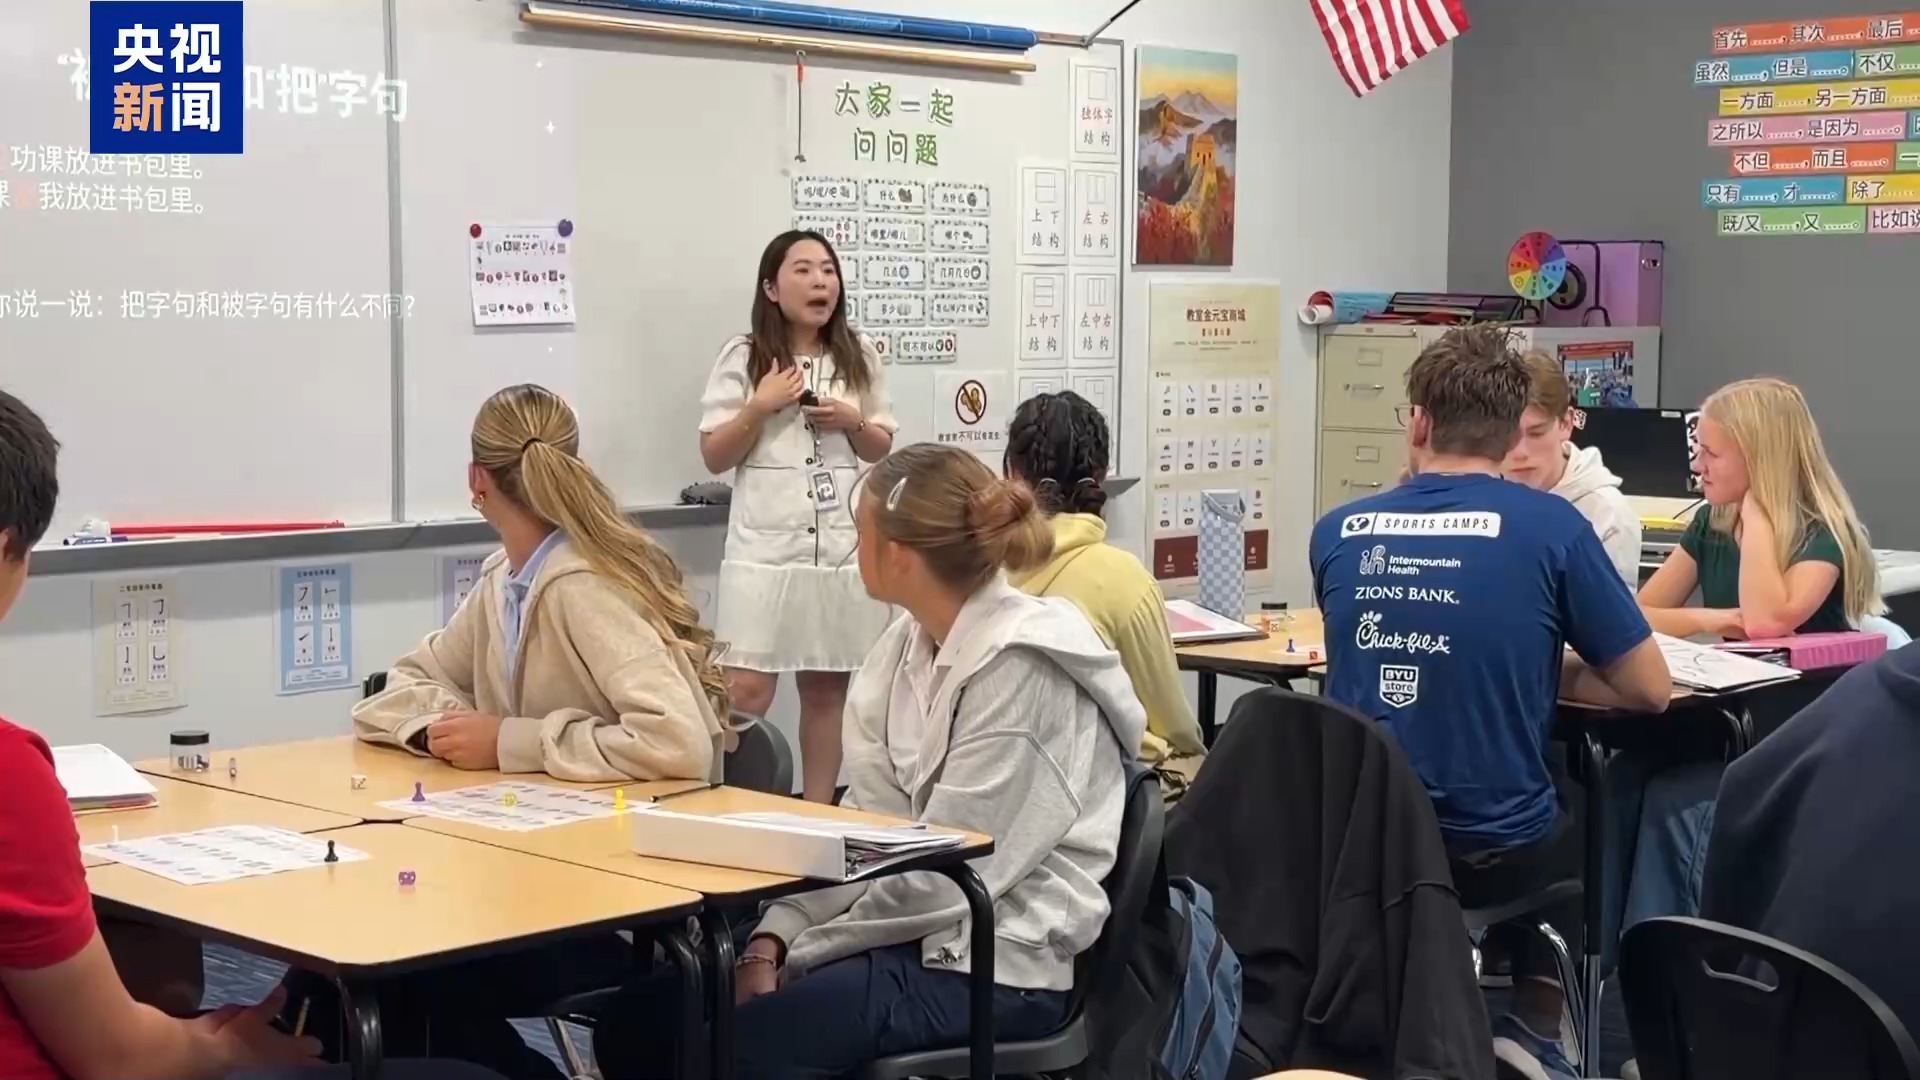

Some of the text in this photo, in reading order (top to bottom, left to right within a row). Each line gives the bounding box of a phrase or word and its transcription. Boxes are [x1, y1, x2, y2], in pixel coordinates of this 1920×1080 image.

[1714, 20, 1903, 49] 首先 其次 最后
[1696, 58, 1807, 82] 虽然 但是
[1860, 53, 1896, 73] 不仅
[835, 81, 954, 125] 大家一起
[1723, 87, 1886, 110] 一方面 另一方面
[1713, 118, 1859, 141] 之所以 是因为
[854, 128, 939, 166] 问问题
[1736, 149, 1847, 170] 不但 而且
[1708, 185, 1740, 202] 只有
[1852, 181, 1886, 198] 除了
[1031, 208, 1060, 225] 上下
[1083, 210, 1109, 225] 左右
[1026, 313, 1060, 328] 上中下
[1080, 312, 1112, 328] 左中右
[1384, 517, 1435, 529] SPORTS
[1443, 517, 1489, 529] CAMPS
[1389, 555, 1461, 568] Intermountain
[1387, 565, 1420, 576] Health
[1355, 586, 1404, 600] ZIONS
[1356, 613, 1450, 654] Chick-fil-A
[1385, 669, 1415, 681] BYU
[1384, 682, 1414, 692] store
